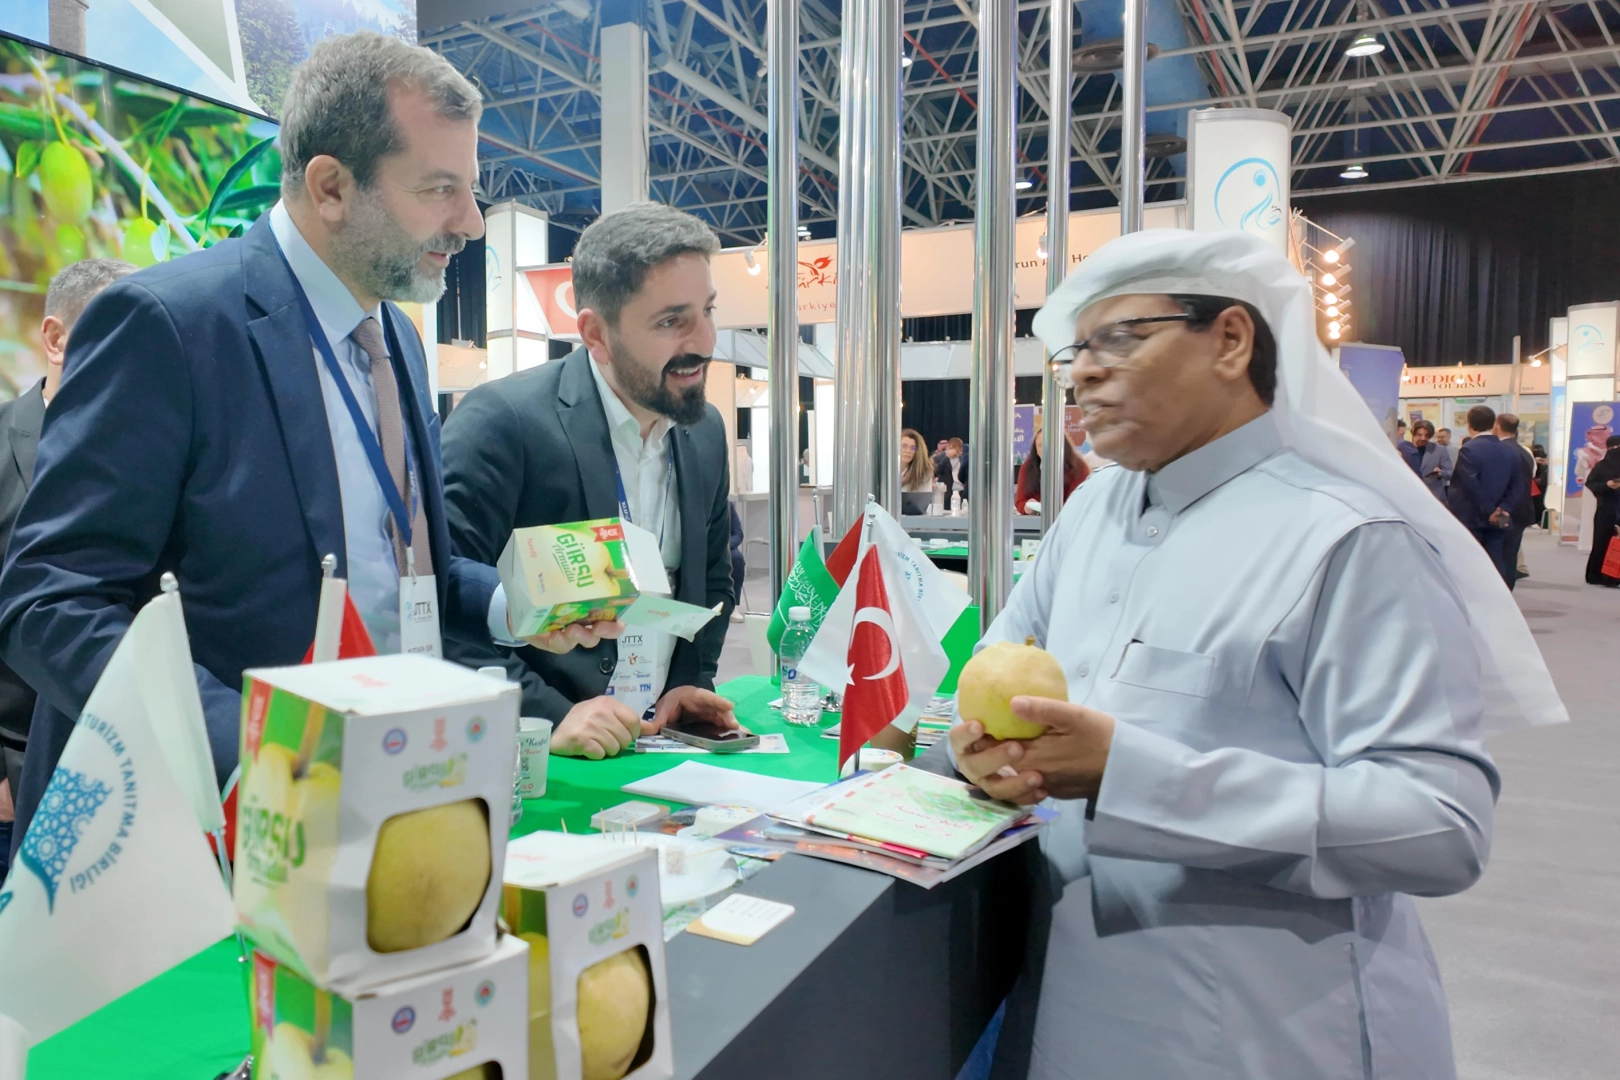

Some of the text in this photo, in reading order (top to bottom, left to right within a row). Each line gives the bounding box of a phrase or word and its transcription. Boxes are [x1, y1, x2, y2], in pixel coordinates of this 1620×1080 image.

[1014, 253, 1089, 268] run Ho
[1432, 380, 1486, 389] TOURISM
[552, 543, 575, 583] Armudu
[556, 532, 595, 589] GÜRSU
[911, 560, 924, 587] TANITMA
[413, 601, 432, 615] JTTX
[622, 635, 643, 644] JTTX
[84, 712, 126, 757] TURİZM
[119, 757, 138, 838] TANITMA
